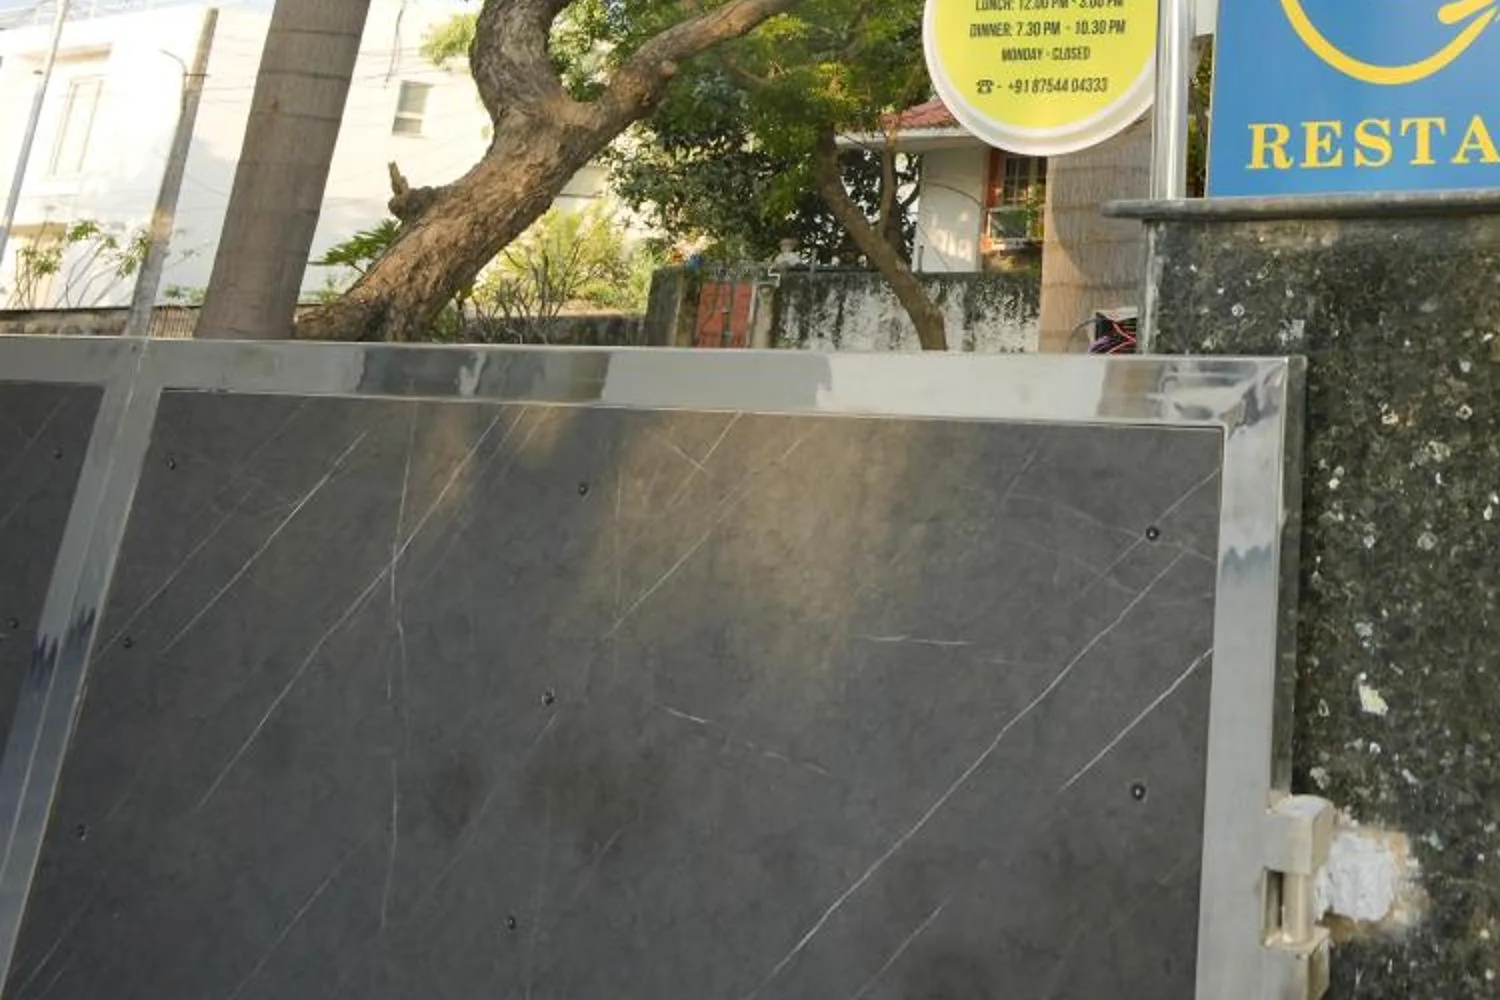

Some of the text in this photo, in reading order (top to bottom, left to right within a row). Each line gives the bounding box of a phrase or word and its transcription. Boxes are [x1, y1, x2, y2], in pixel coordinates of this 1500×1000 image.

[1016, 21, 1041, 37] 7.30
[1042, 20, 1061, 36] PM
[1074, 19, 1107, 35] 10.30
[1108, 18, 1126, 34] PM
[1001, 46, 1043, 62] MONDAY
[1051, 45, 1091, 61] CLOSED
